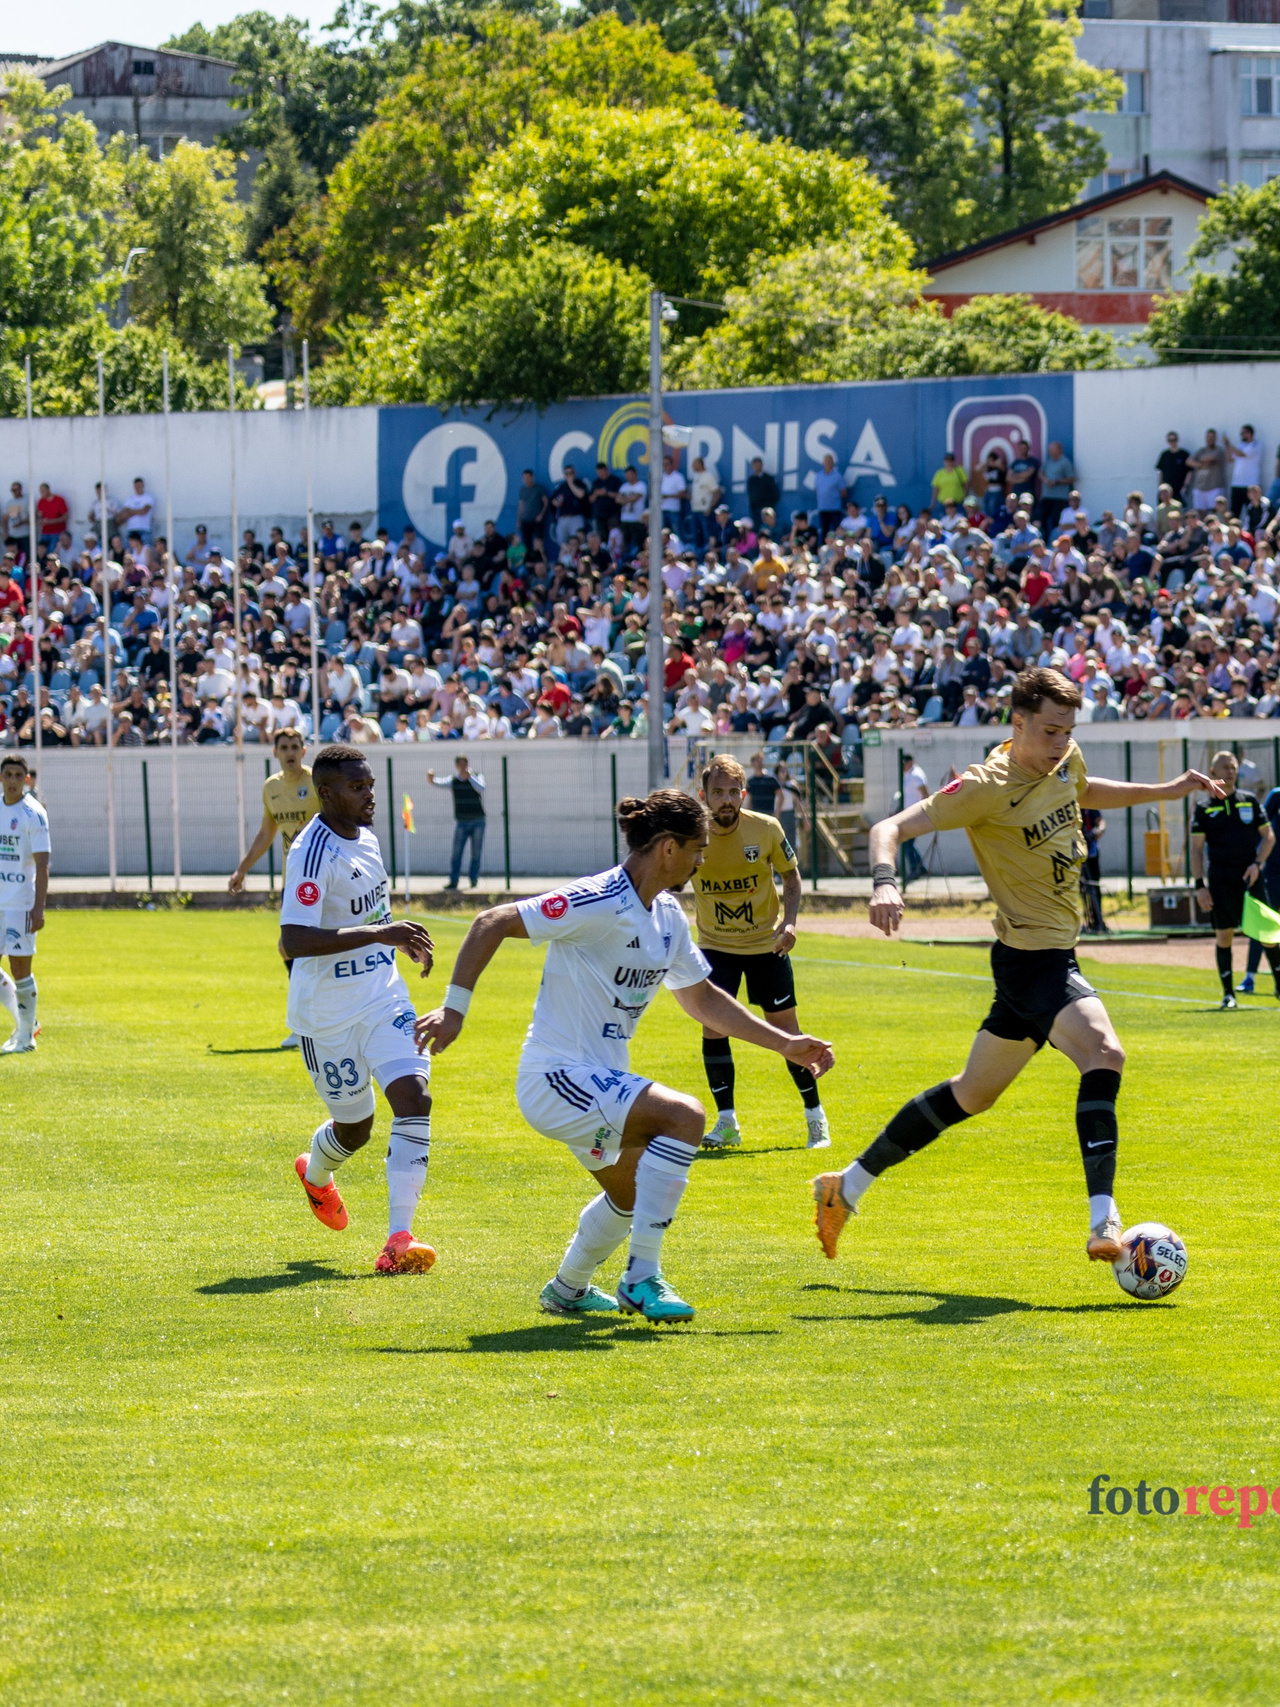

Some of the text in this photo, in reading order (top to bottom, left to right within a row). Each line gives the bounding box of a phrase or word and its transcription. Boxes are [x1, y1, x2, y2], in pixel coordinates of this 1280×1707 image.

[272, 811, 307, 822] MAXBET
[1022, 799, 1078, 847] MAXBET
[701, 875, 759, 892] MAXBET
[613, 966, 669, 989] UNIBET
[323, 1058, 359, 1090] 83
[1156, 1246, 1187, 1270] SELECT
